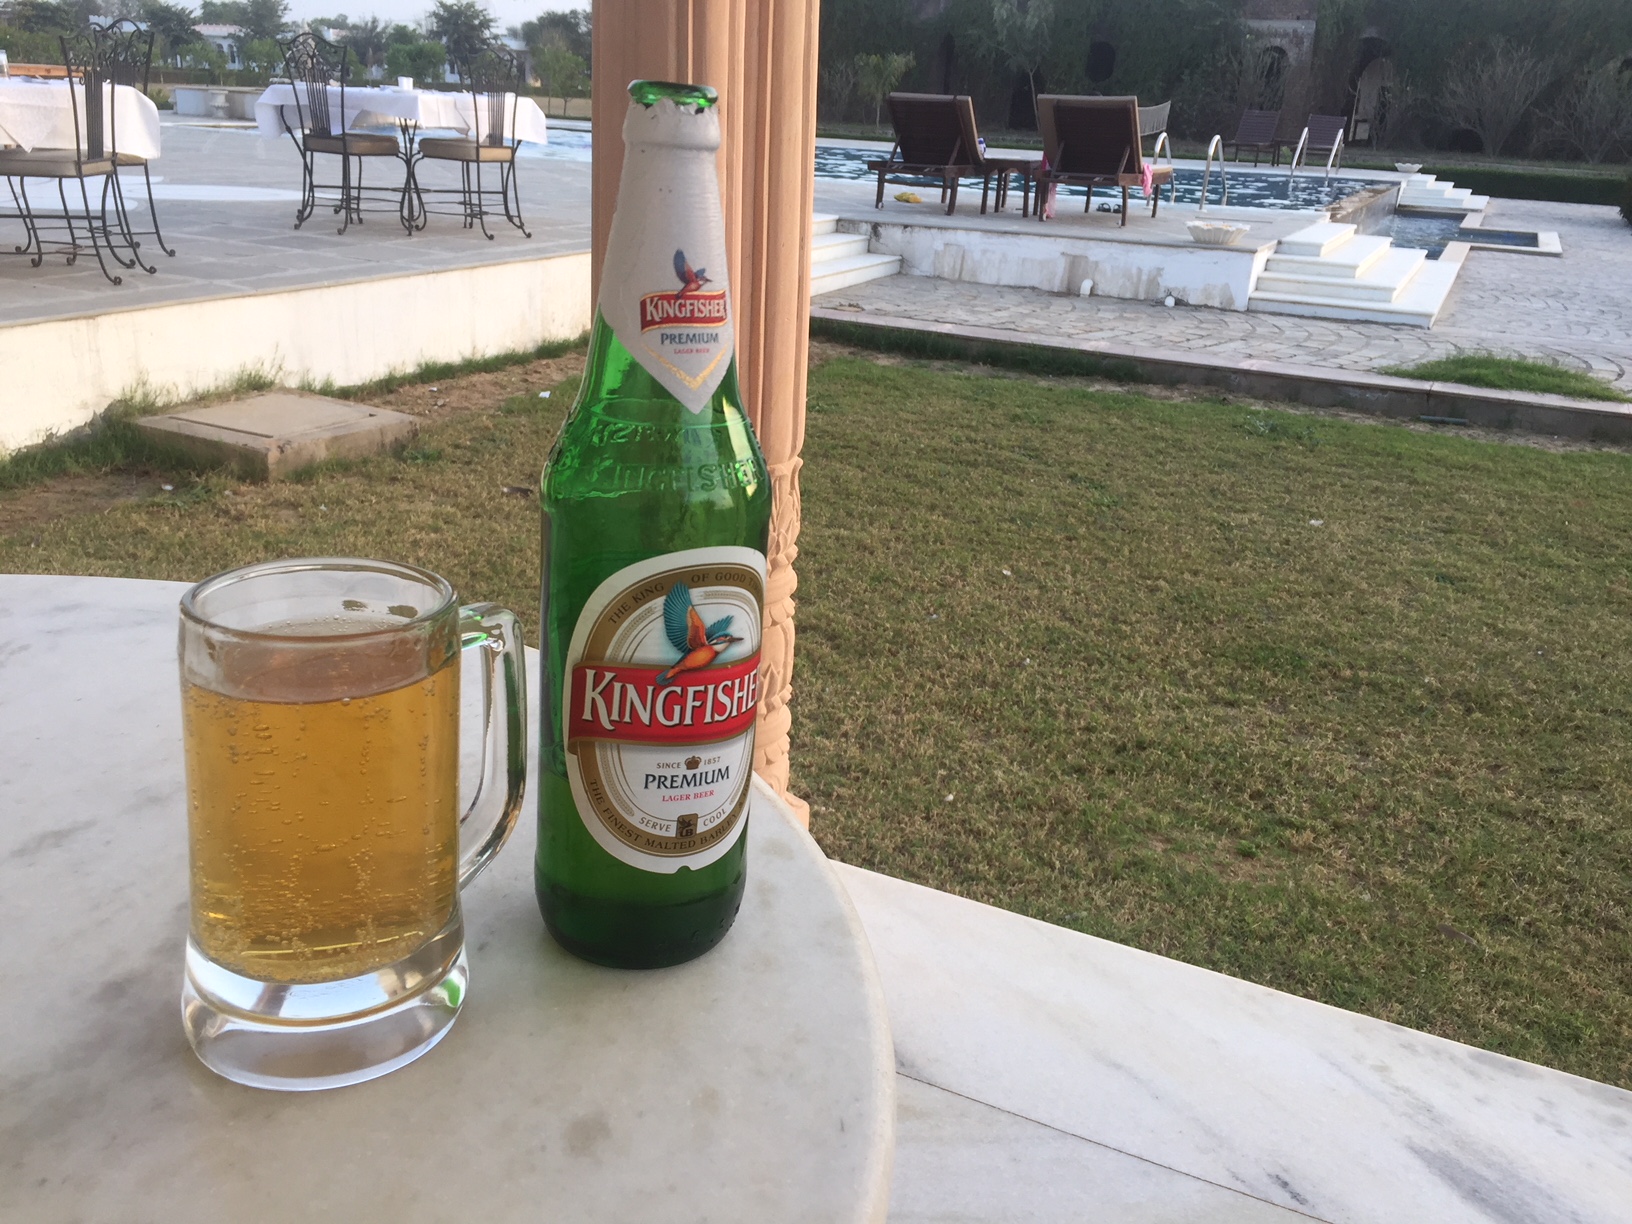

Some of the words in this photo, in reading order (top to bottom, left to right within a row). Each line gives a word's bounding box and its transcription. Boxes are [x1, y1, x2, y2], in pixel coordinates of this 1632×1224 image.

[646, 297, 726, 322] KINGFISHER
[660, 333, 719, 345] PREMIUM
[608, 603, 631, 625] THE
[632, 582, 664, 604] KING
[691, 573, 709, 583] OF
[715, 571, 746, 583] GOOD
[582, 666, 759, 730] KINGFISHE
[656, 761, 681, 769] SINCE
[703, 756, 721, 765] 1857
[643, 765, 730, 790] PREMIUM
[662, 794, 691, 802] LAGER
[693, 789, 714, 799] BEER
[589, 779, 604, 805] THE
[603, 807, 643, 842] FINEST
[644, 839, 696, 850] MALTED
[700, 813, 739, 845] BARLEY
[639, 816, 671, 832] SERVE
[703, 807, 727, 827] COOL
